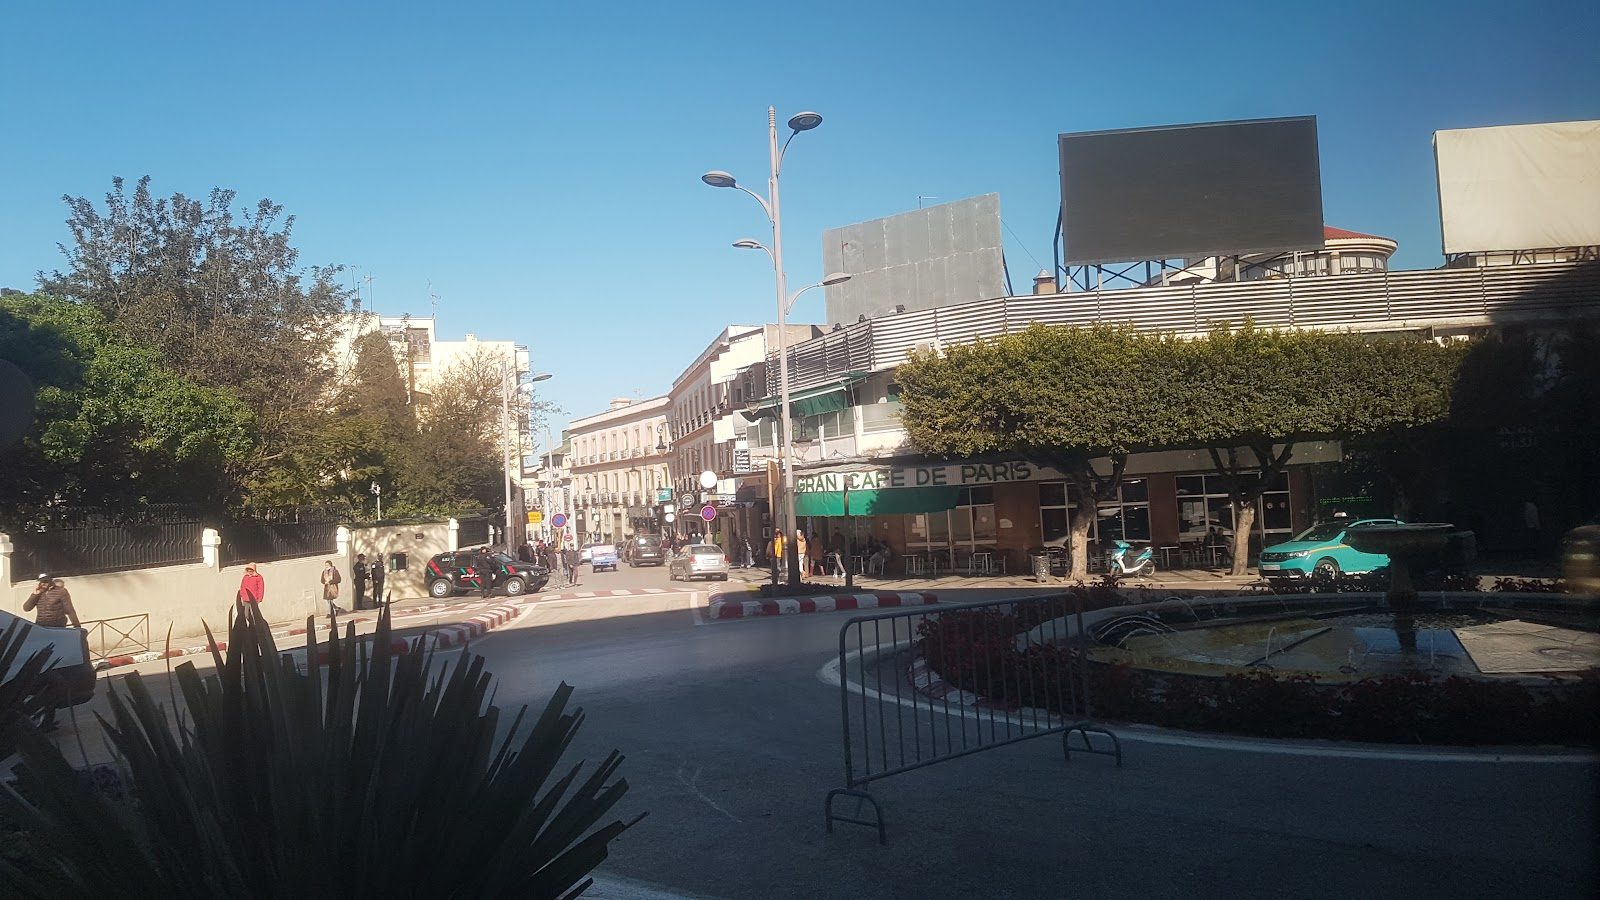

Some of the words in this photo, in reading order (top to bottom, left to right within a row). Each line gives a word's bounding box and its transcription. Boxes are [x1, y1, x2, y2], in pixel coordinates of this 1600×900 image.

[796, 473, 837, 492] GRAN
[850, 470, 905, 489] CAFE
[916, 467, 946, 486] DE
[961, 462, 1031, 483] PARIS
